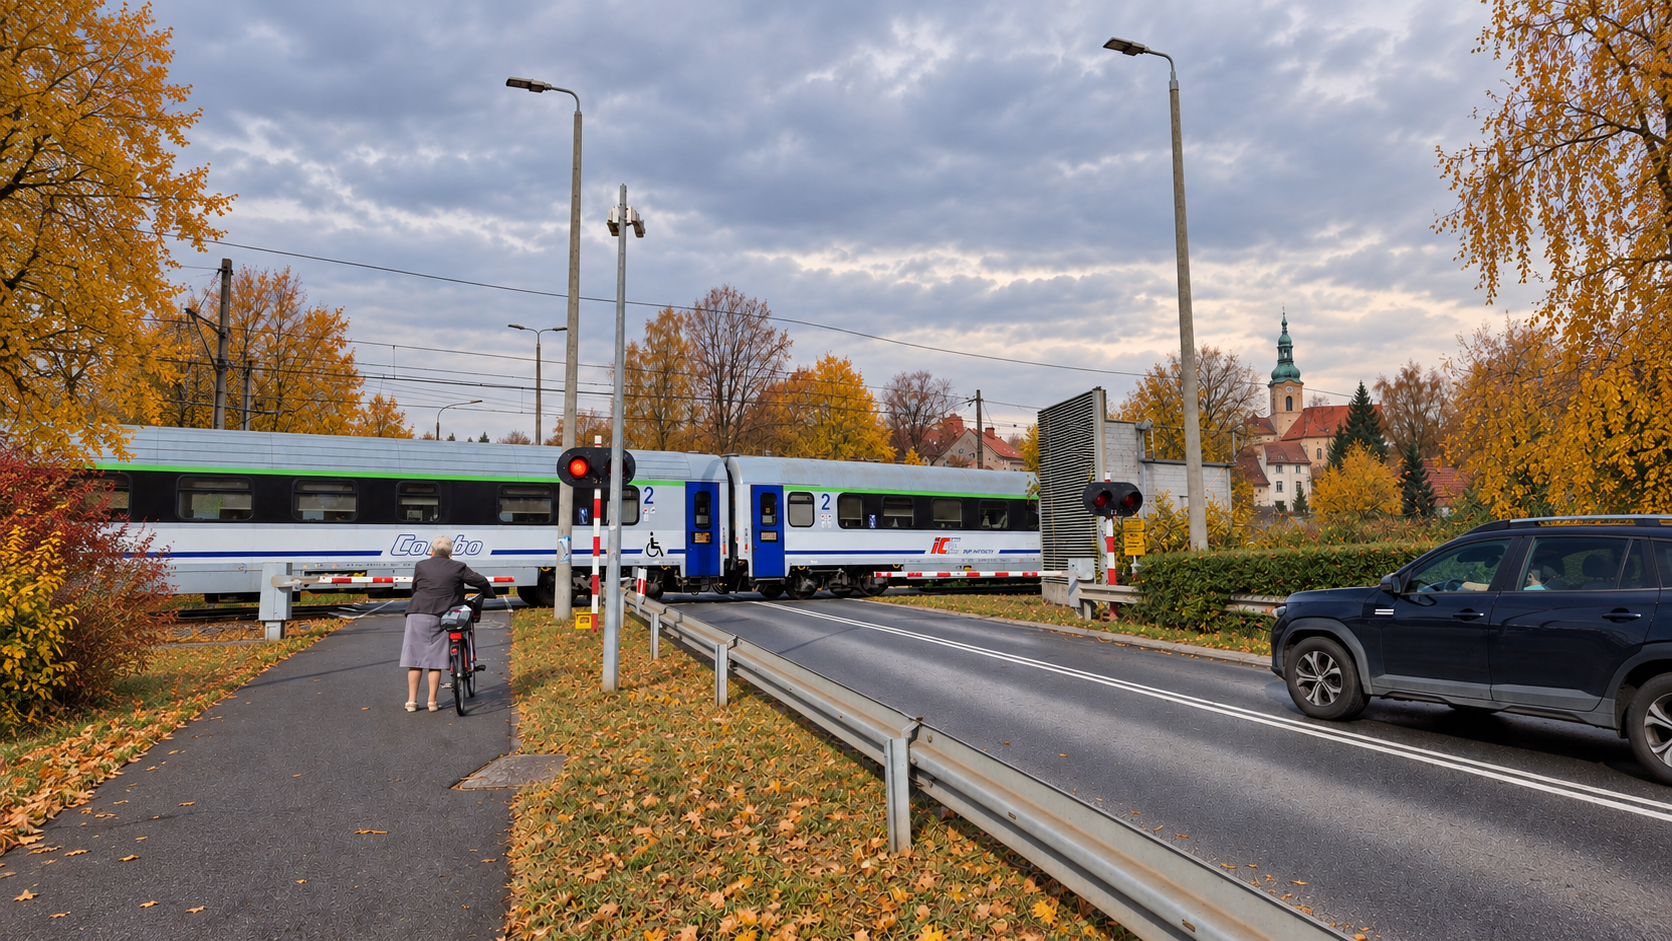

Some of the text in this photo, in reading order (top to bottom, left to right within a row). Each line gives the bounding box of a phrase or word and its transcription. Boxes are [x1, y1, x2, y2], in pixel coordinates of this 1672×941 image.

[644, 486, 654, 504] 2
[821, 493, 831, 510] 2
[390, 534, 483, 556] Cobo
